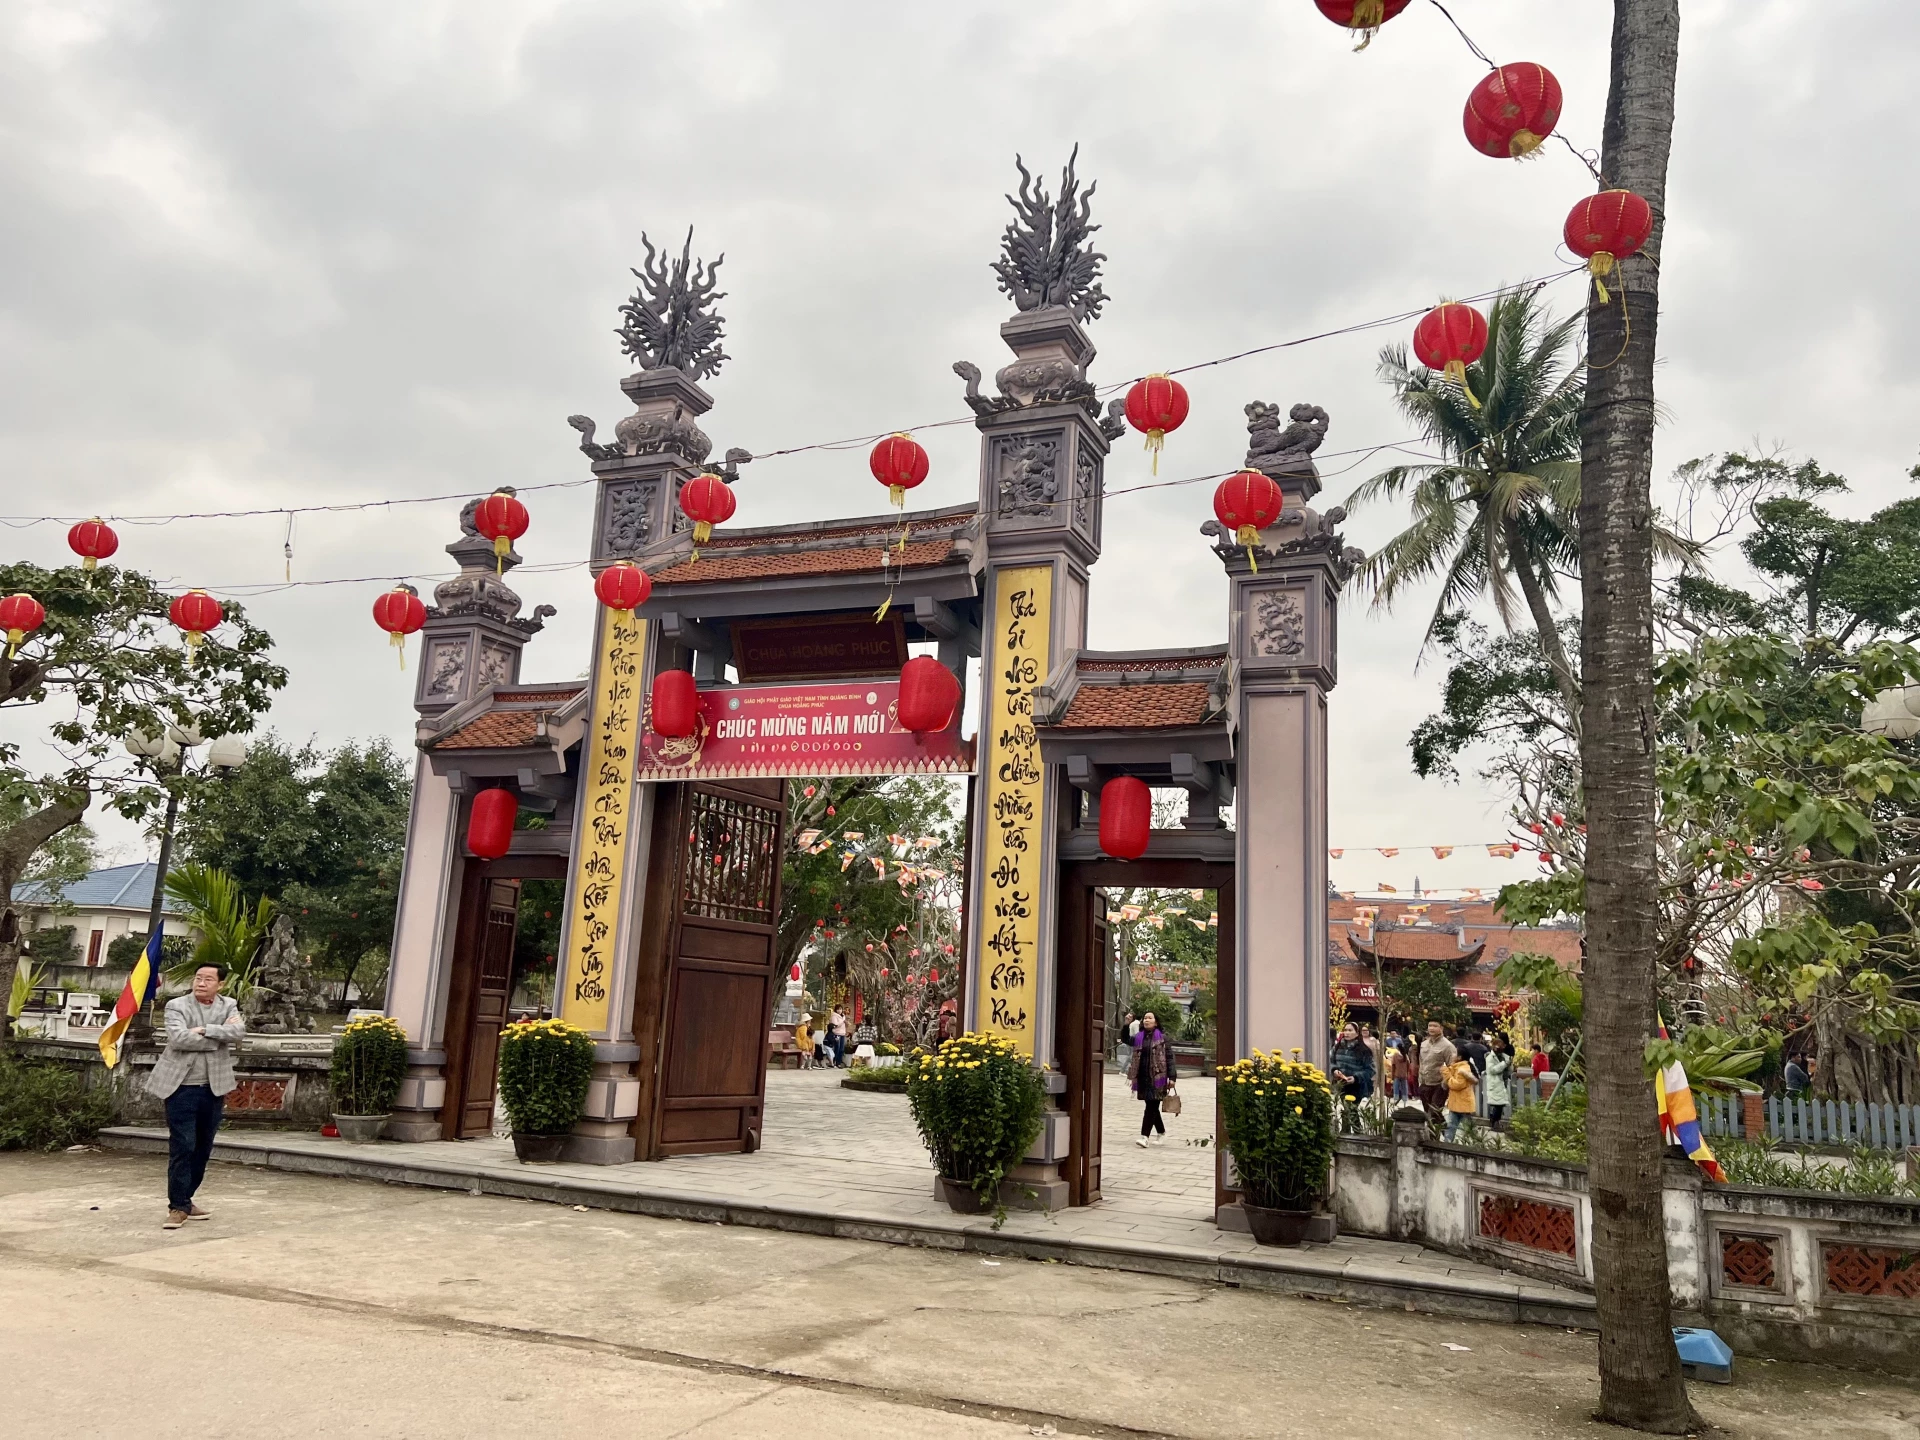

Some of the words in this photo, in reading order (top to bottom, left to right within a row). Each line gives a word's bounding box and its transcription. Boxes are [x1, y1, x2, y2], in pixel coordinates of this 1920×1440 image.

[1009, 588, 1037, 619] Phá
[851, 637, 891, 656] PHÚC
[603, 704, 632, 732] Hết
[716, 714, 758, 739] CHÚC
[760, 712, 807, 737] MỪNG
[811, 711, 849, 736] NĂM
[853, 710, 886, 735] MỚI
[991, 854, 1020, 888] Đó
[987, 923, 1034, 957] Hết
